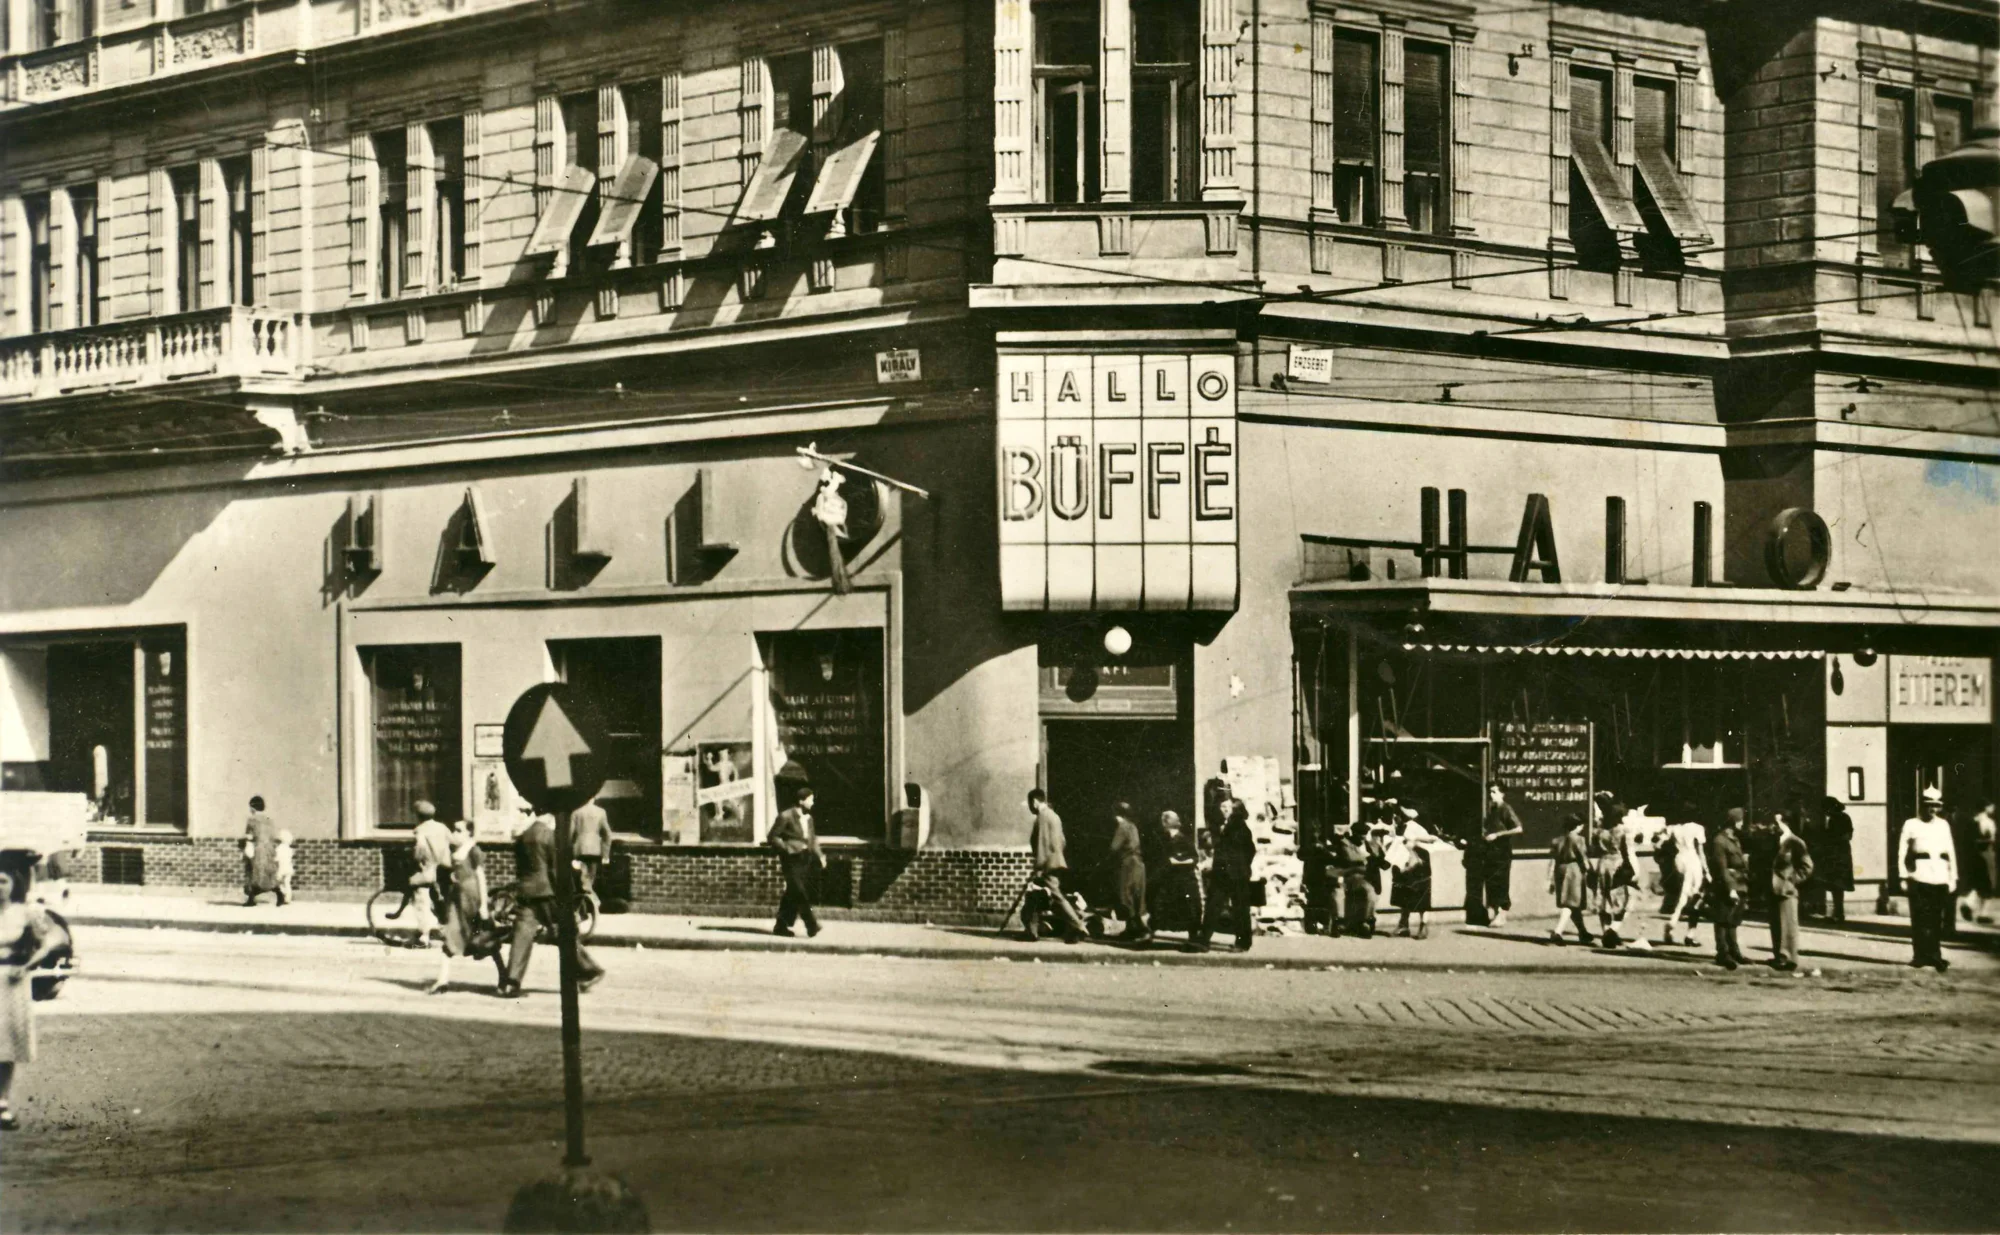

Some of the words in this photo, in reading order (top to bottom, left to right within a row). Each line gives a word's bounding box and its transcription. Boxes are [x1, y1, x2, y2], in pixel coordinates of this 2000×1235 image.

[1010, 369, 1229, 402] HALLO
[1002, 427, 1233, 521] BÜFFÉ
[321, 462, 890, 602] HALLO
[1420, 486, 1832, 591] HALLO
